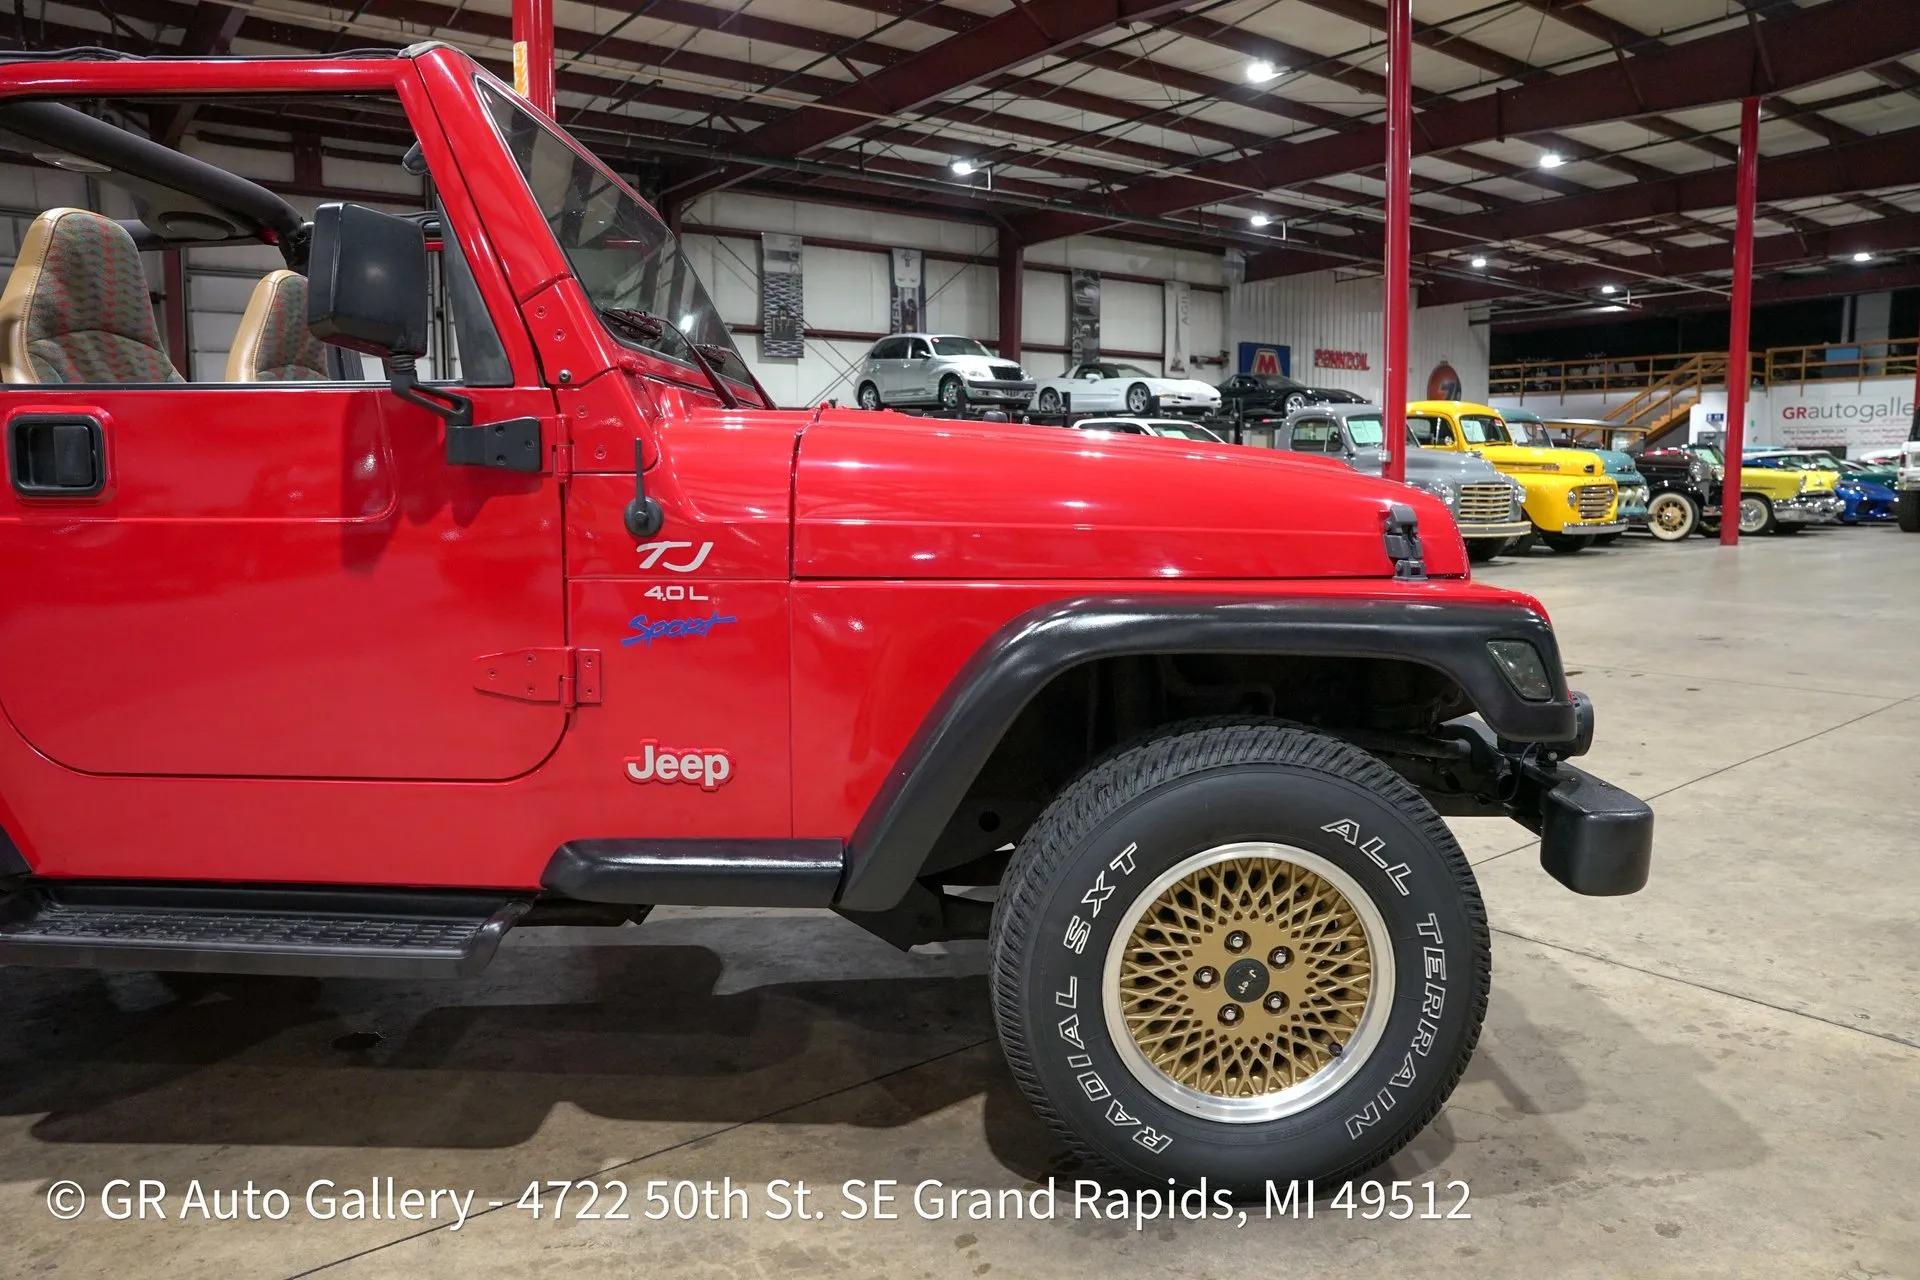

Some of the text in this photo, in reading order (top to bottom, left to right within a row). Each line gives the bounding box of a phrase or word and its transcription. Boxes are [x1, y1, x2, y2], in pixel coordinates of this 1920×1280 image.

[636, 541, 714, 573] TJ
[626, 744, 731, 788] Jeep
[1056, 842, 1173, 1154] RADIAL SXT
[1320, 818, 1447, 1142] ALL TERRAIN
